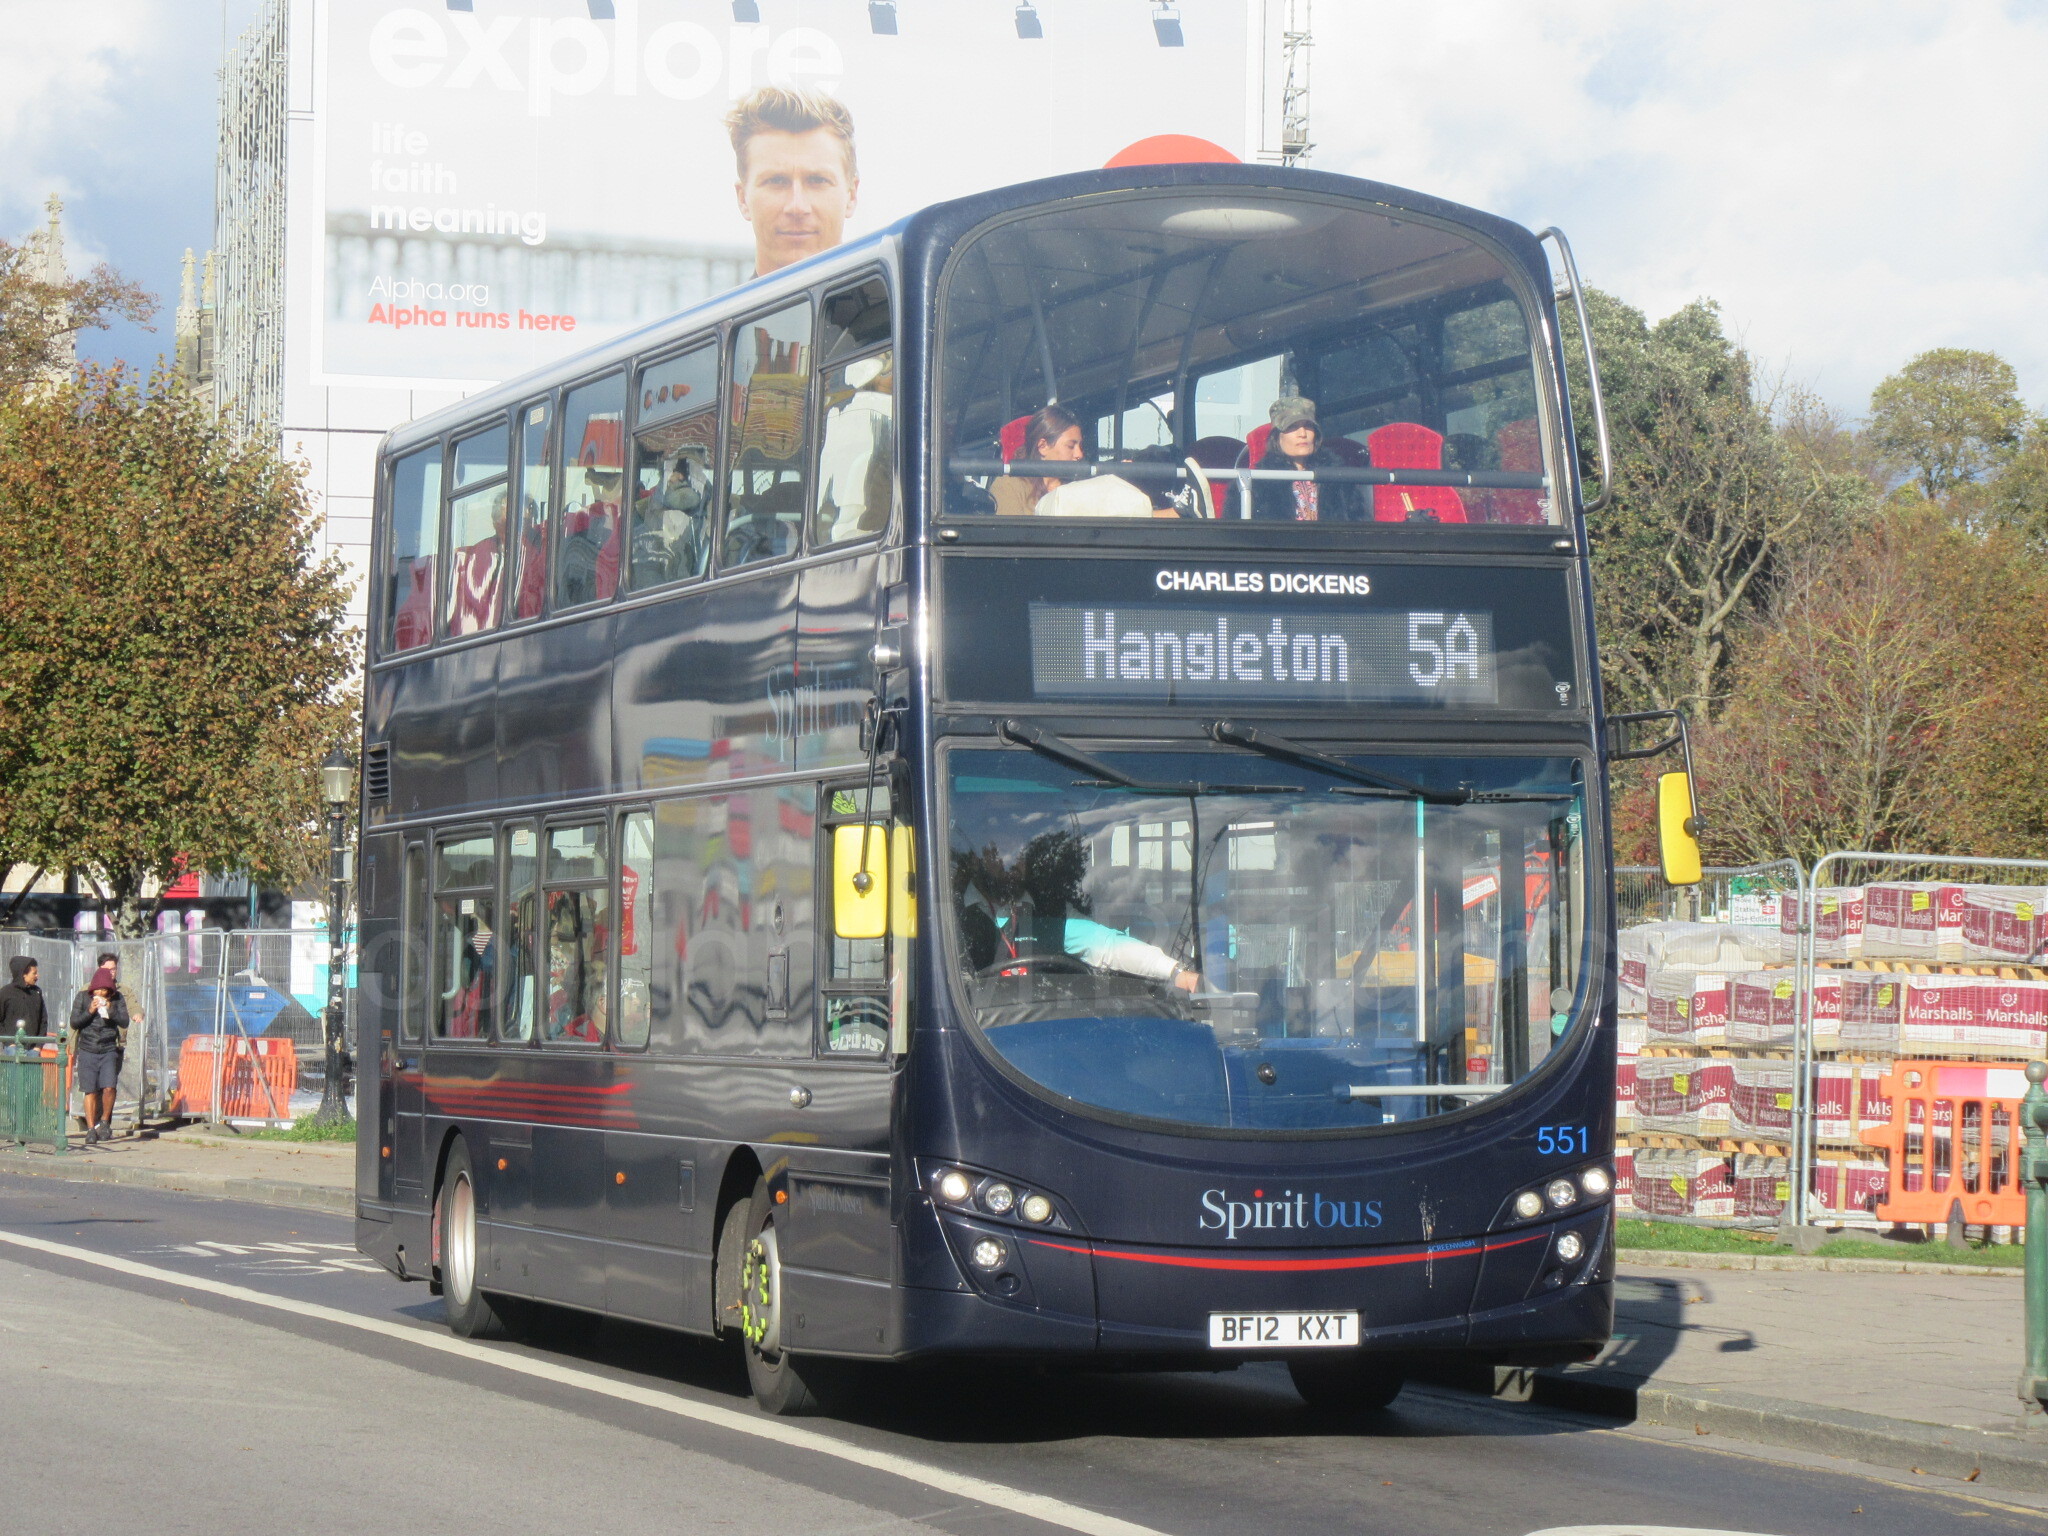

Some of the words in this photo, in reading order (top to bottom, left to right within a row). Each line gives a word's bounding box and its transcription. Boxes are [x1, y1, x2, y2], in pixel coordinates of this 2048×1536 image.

[369, 0, 844, 116] explore
[371, 122, 429, 156] life
[370, 160, 458, 196] faith
[370, 203, 548, 246] meaning
[367, 276, 490, 307] Alpha.org
[367, 302, 447, 330] Alpha
[456, 310, 511, 330] runs
[518, 308, 577, 332] here
[1156, 570, 1264, 593] CHARLES
[1269, 573, 1371, 595] DICKENS
[1083, 611, 1349, 683] Hangleton
[1408, 611, 1479, 687] 5A
[1909, 1006, 1974, 1021] Marshalls
[1986, 1008, 2048, 1027] Marshalls
[1537, 1126, 1589, 1155] 551
[1427, 1239, 1476, 1253] SCREENWASH
[1222, 1316, 1279, 1342] BF12
[1298, 1315, 1348, 1341] KXT
